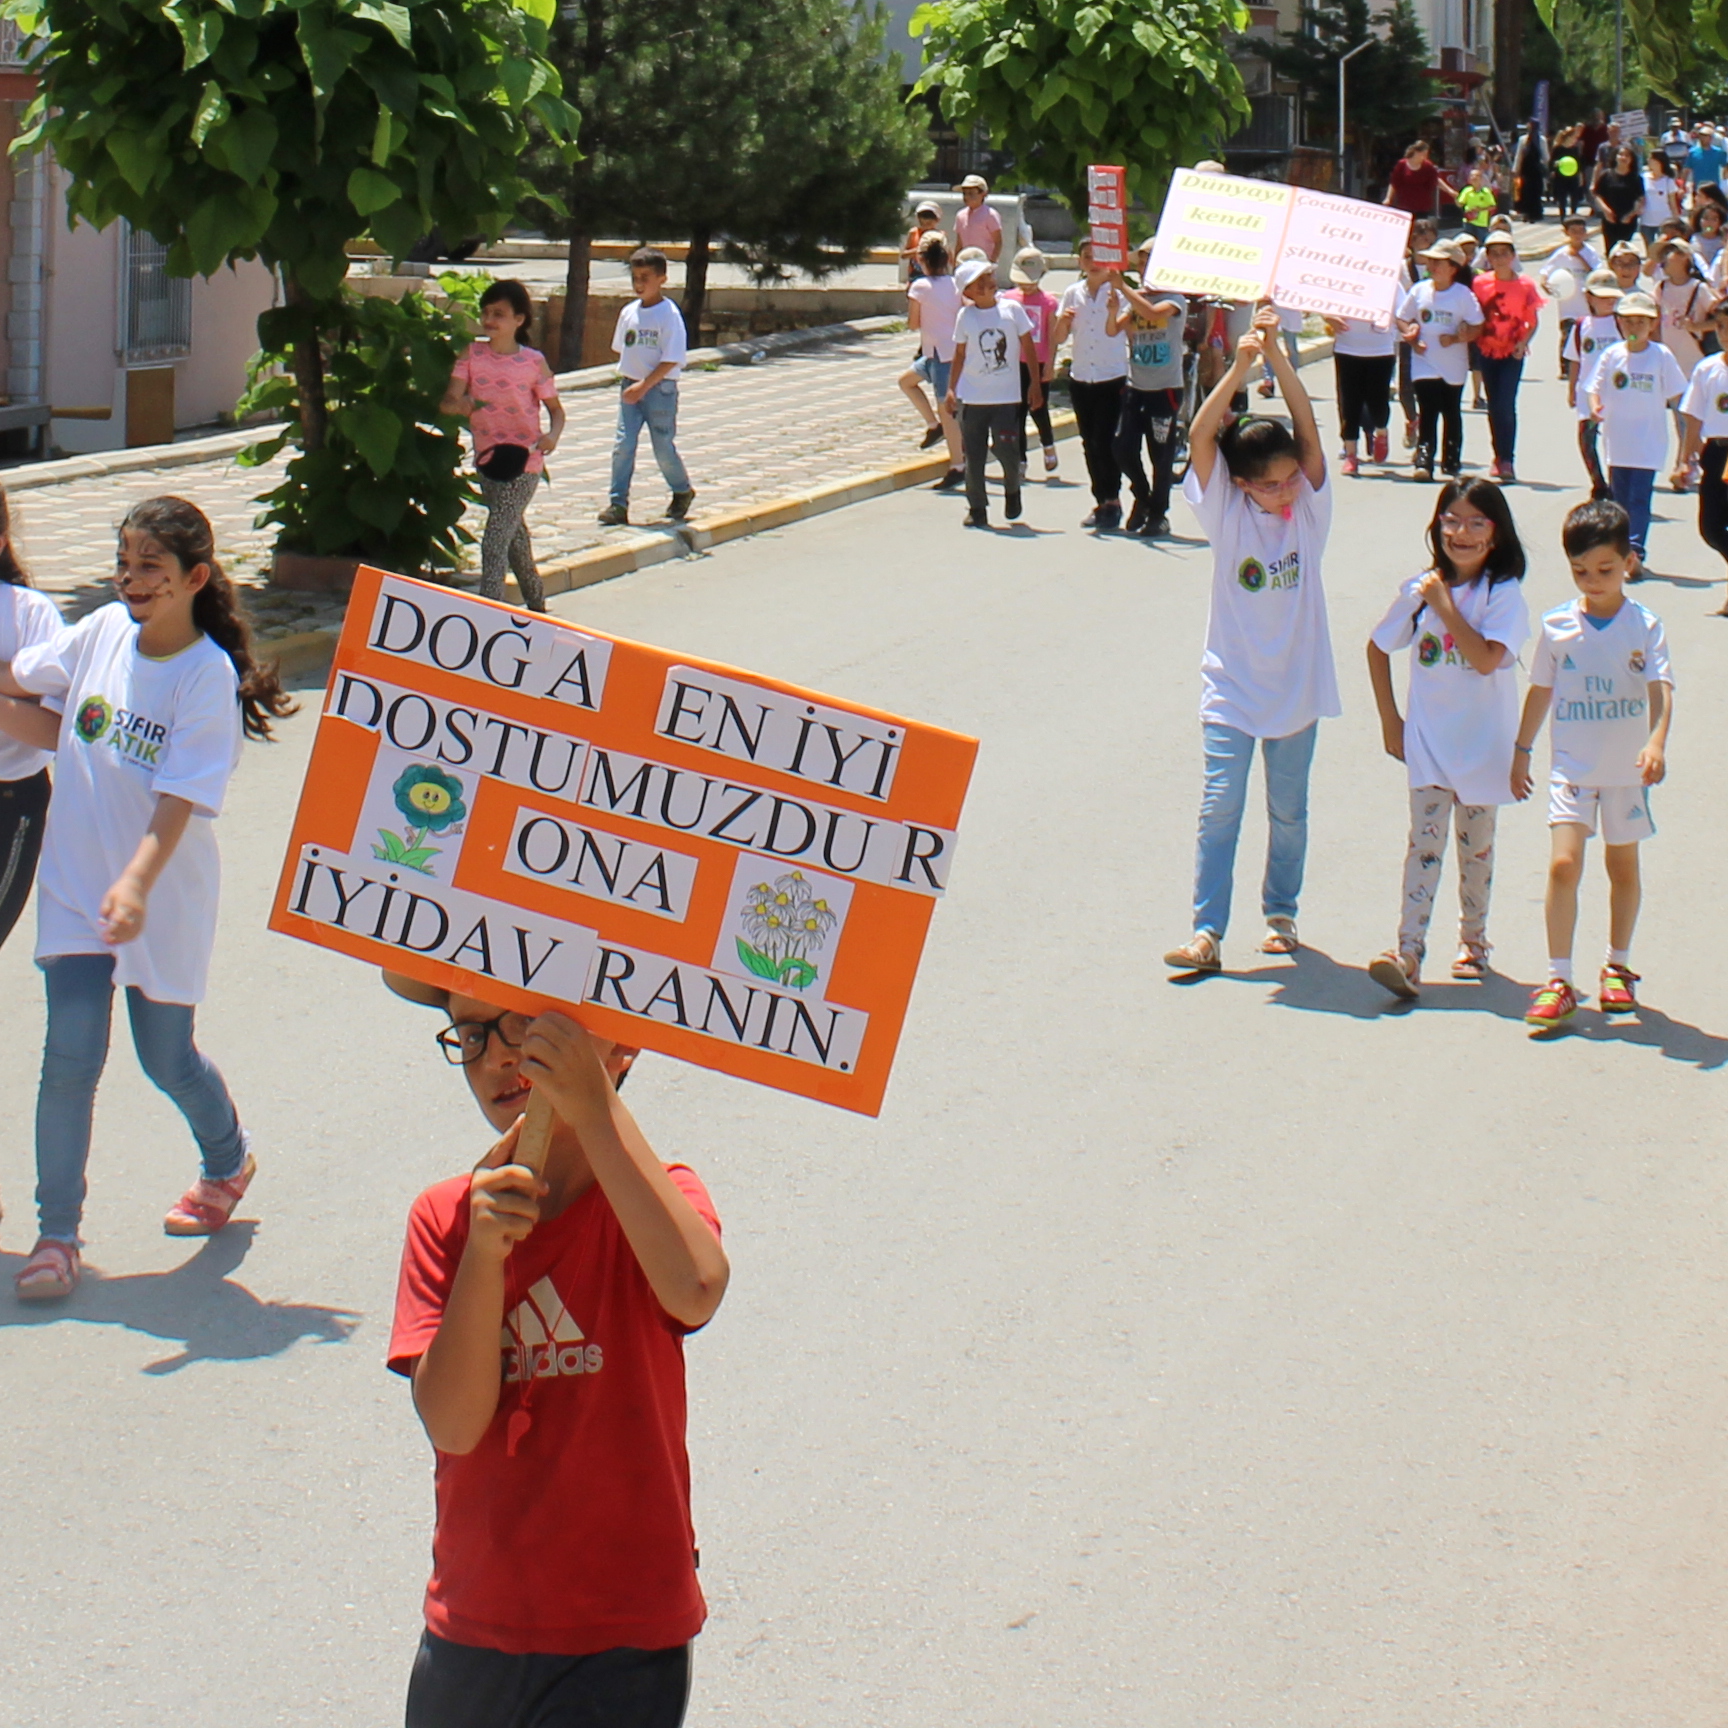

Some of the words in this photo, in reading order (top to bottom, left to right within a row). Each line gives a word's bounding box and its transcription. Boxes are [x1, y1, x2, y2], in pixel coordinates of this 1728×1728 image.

[1181, 174, 1288, 203] Dünyayı
[1189, 206, 1263, 229] kendi
[1296, 193, 1408, 228] Çocuklarım
[1320, 222, 1365, 244] için
[1175, 236, 1259, 263] haline
[1283, 243, 1397, 279] şimdiden
[1154, 268, 1263, 297] bırakın!
[1298, 271, 1367, 296] çevre
[1274, 287, 1392, 324] diyorum!
[1268, 551, 1299, 576] SIFIR
[1271, 568, 1300, 591] ATIK
[1584, 675, 1614, 695] Fly
[1555, 695, 1646, 721] Emirates
[113, 708, 167, 744] SIFIR
[658, 677, 766, 762] EN
[787, 704, 905, 802] İYİ
[106, 728, 162, 765] ATIK
[515, 816, 674, 914] ONA
